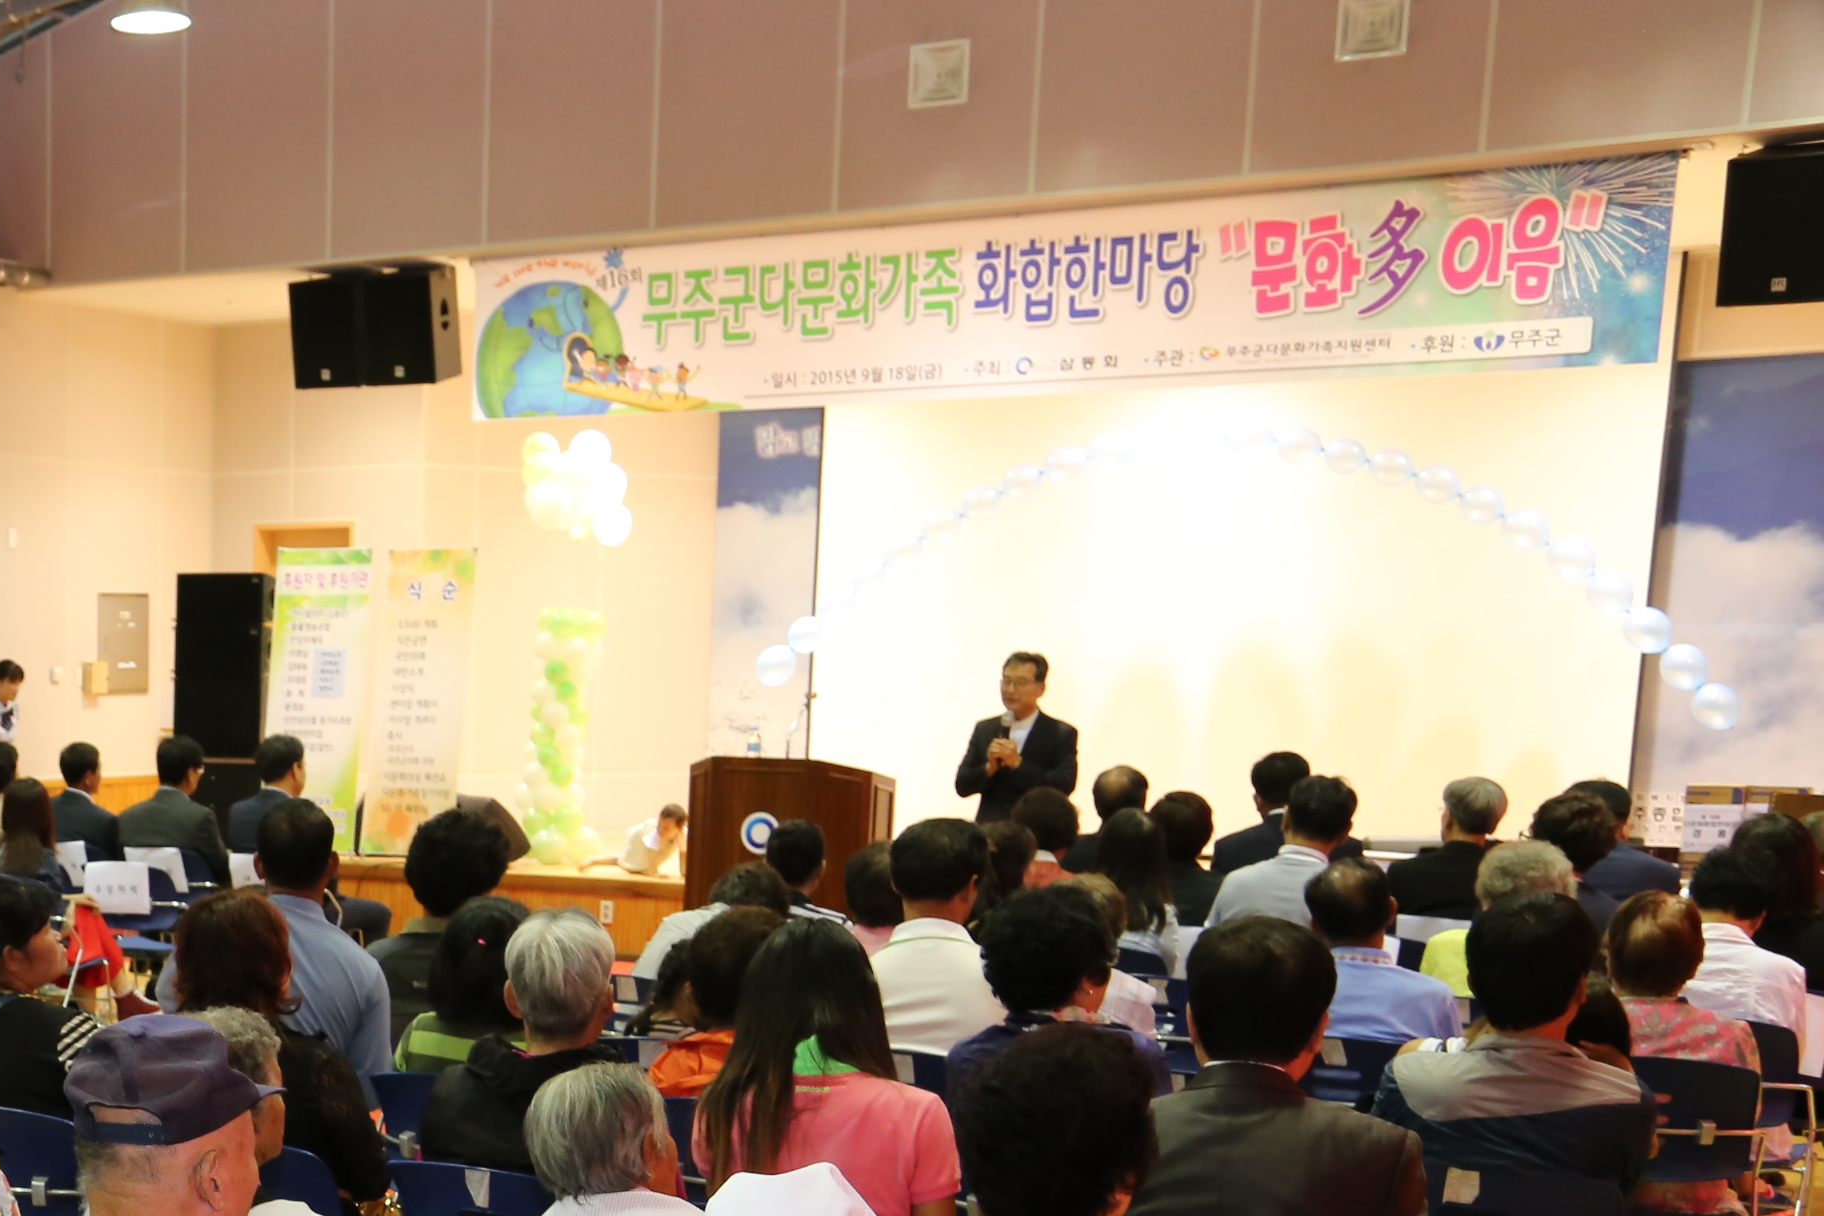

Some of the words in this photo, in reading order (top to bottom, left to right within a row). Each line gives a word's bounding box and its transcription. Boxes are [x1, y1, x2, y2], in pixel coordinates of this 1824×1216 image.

[596, 266, 643, 291] 제16회
[642, 247, 963, 347] 무주군다문화가족
[974, 228, 1200, 322] 화합한마당
[810, 368, 857, 386] 2015년
[861, 366, 883, 383] 9월
[888, 362, 943, 382] 18일(금)
[1508, 328, 1563, 349] 무주군
